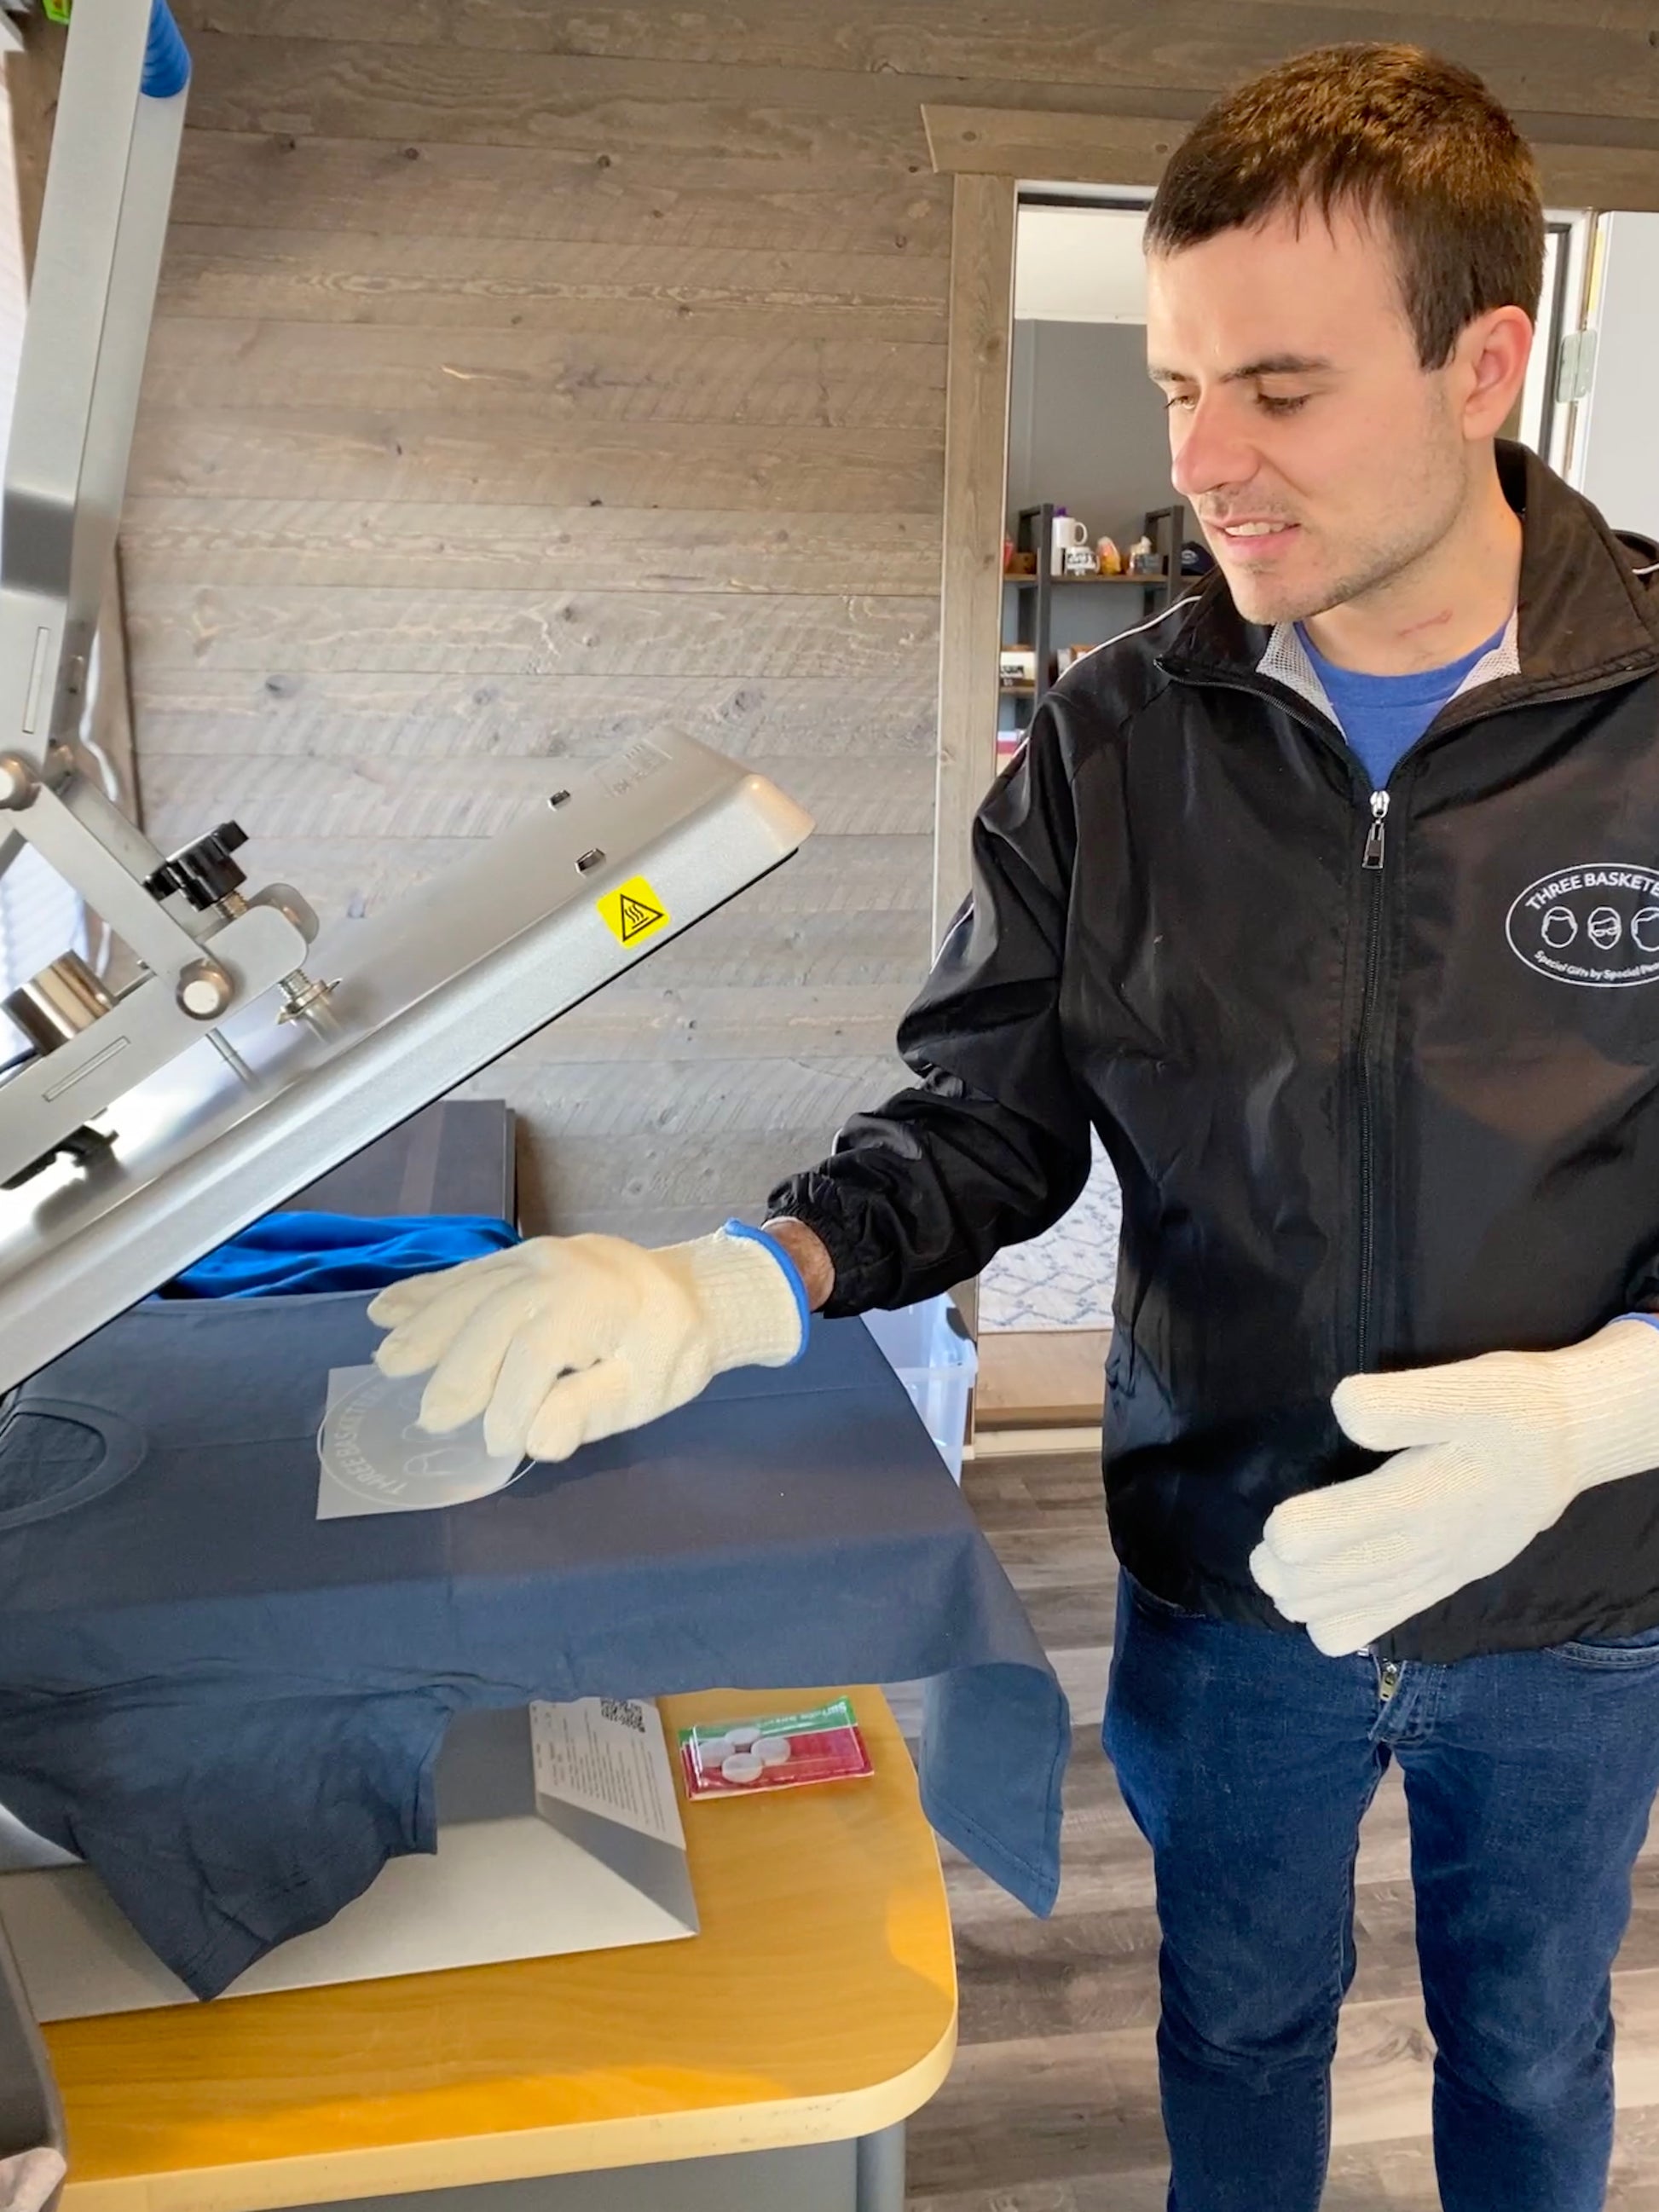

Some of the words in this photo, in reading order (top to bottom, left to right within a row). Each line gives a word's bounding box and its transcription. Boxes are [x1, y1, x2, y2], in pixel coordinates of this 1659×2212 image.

[1524, 874, 1583, 910] THREE
[1534, 950, 1569, 973] Special
[1567, 965, 1589, 978] Gifts
[1590, 968, 1604, 981] by
[1603, 966, 1640, 981] Special
[338, 1456, 409, 1497] THREE
